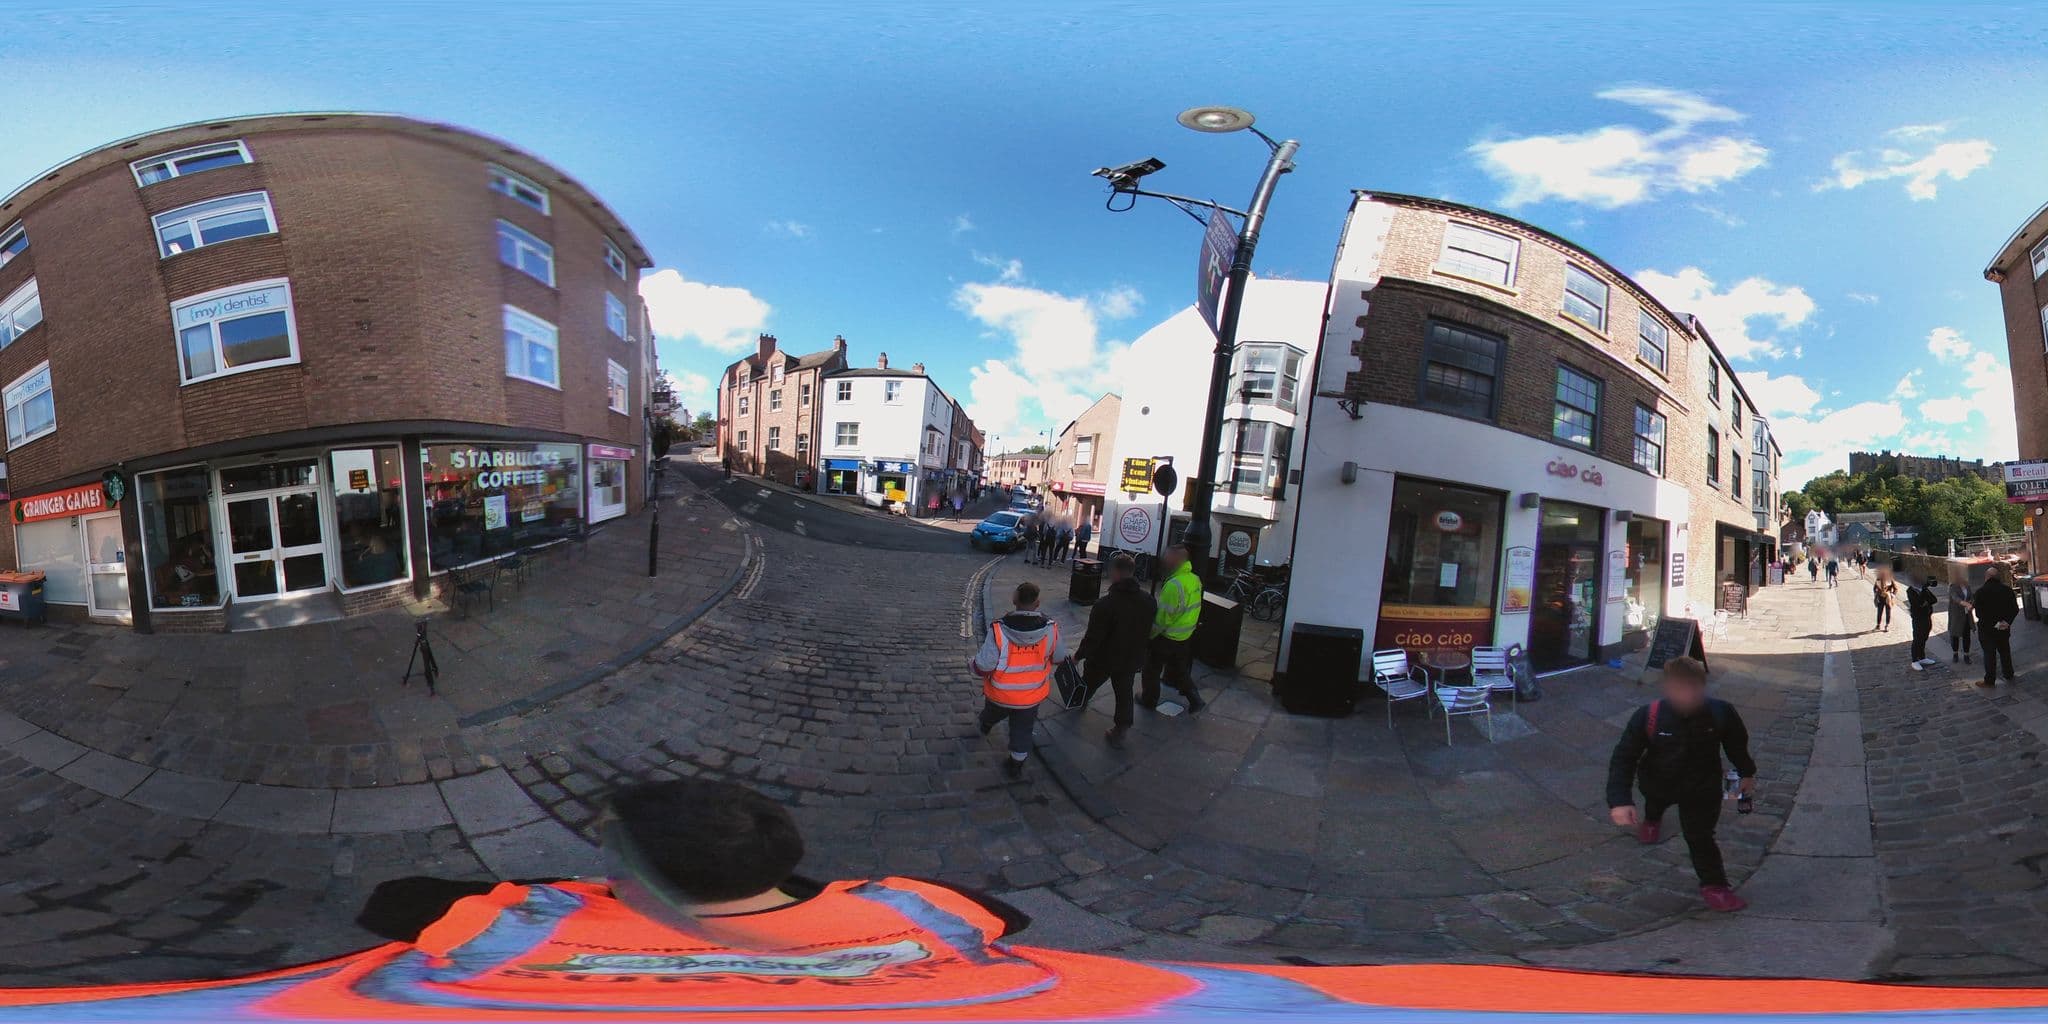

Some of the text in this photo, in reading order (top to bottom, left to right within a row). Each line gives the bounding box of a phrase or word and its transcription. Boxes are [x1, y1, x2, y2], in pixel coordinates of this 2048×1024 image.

[477, 469, 547, 489] COFFEE
[2013, 480, 2048, 491] TO LET
[23, 495, 65, 518] GRAINGER
[66, 488, 101, 511] GAMES
[1395, 628, 1473, 646] ciao ciao
